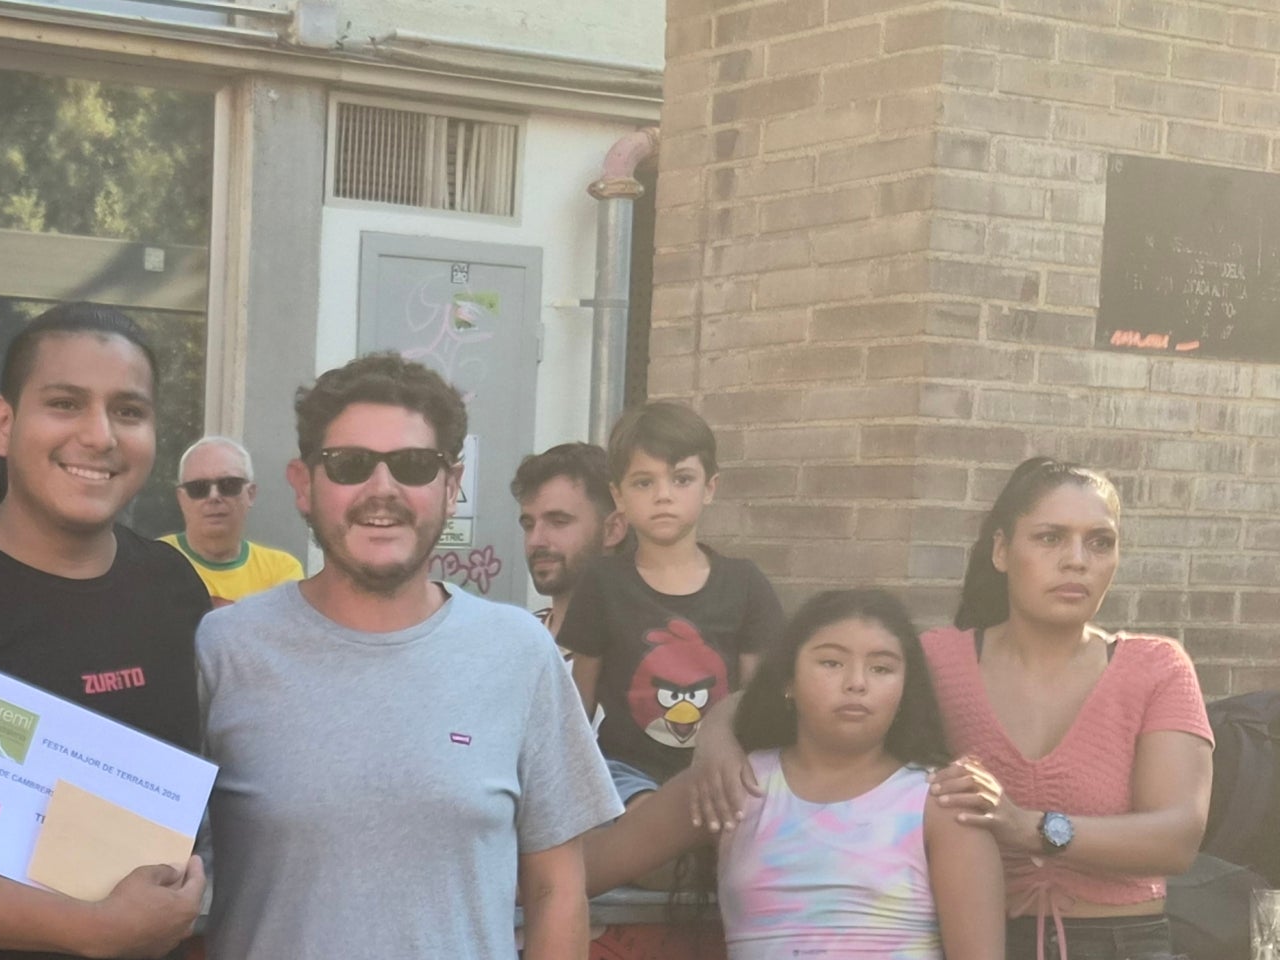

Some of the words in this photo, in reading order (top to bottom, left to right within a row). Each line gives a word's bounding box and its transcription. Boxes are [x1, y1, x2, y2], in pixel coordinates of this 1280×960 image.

[0, 768, 10, 779] DE
[42, 738, 69, 755] FESTA
[70, 750, 101, 768] MAJOR
[102, 763, 114, 775] DE
[116, 769, 160, 796] TERRASSA
